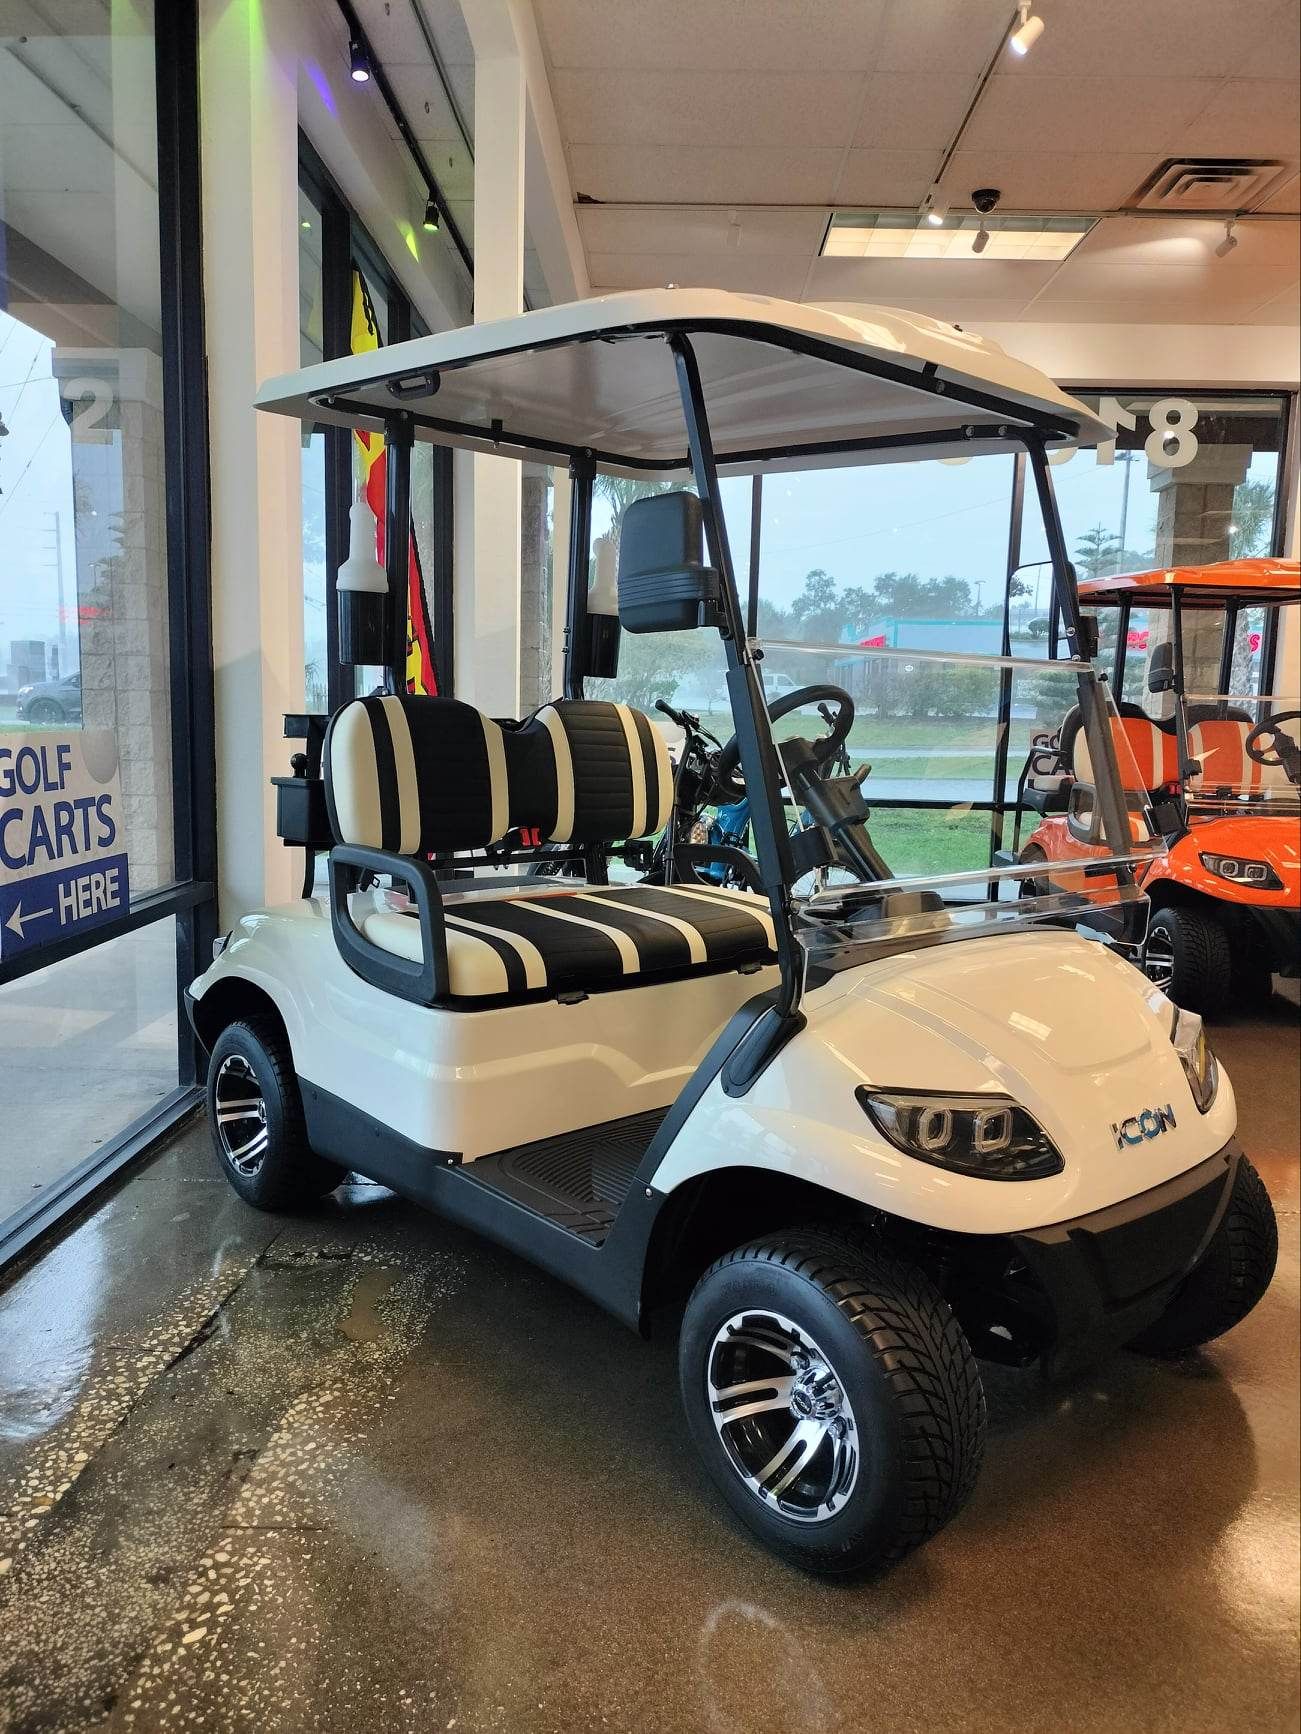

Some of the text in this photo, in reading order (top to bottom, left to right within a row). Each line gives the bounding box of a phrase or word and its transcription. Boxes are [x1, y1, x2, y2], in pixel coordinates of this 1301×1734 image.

[0, 744, 72, 798] GOLF
[0, 794, 116, 870] CARTS
[58, 867, 121, 926] HERE
[1109, 1103, 1177, 1151] ICON
